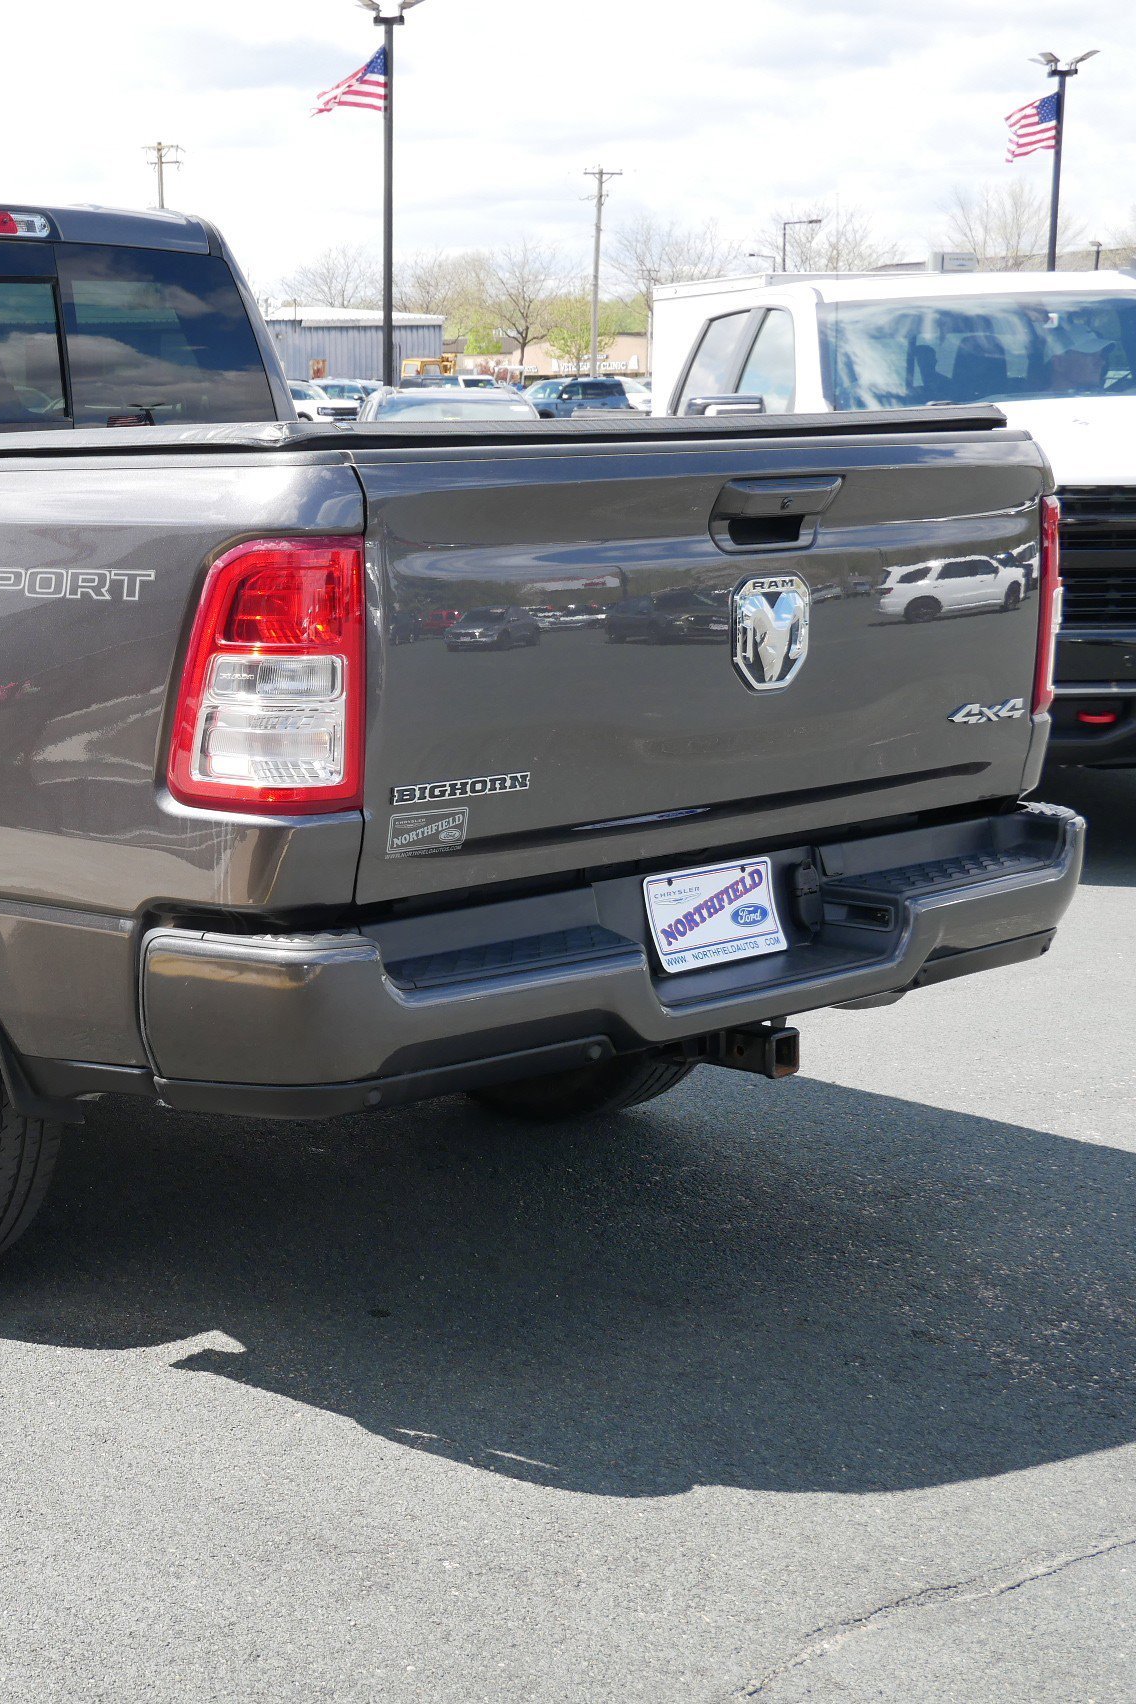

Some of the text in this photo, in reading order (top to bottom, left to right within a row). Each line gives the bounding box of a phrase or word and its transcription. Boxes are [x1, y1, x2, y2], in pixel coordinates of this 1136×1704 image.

[600, 361, 628, 371] CLINIC
[752, 578, 795, 591] RAM
[393, 771, 530, 805] BIGHORN
[392, 813, 464, 848] NORTHFIELD
[654, 886, 700, 899] CHRYSLER
[660, 868, 764, 947] NORTHFIELD
[737, 905, 762, 924] Ford
[691, 940, 760, 961] NORTHFIELDAUTOS
